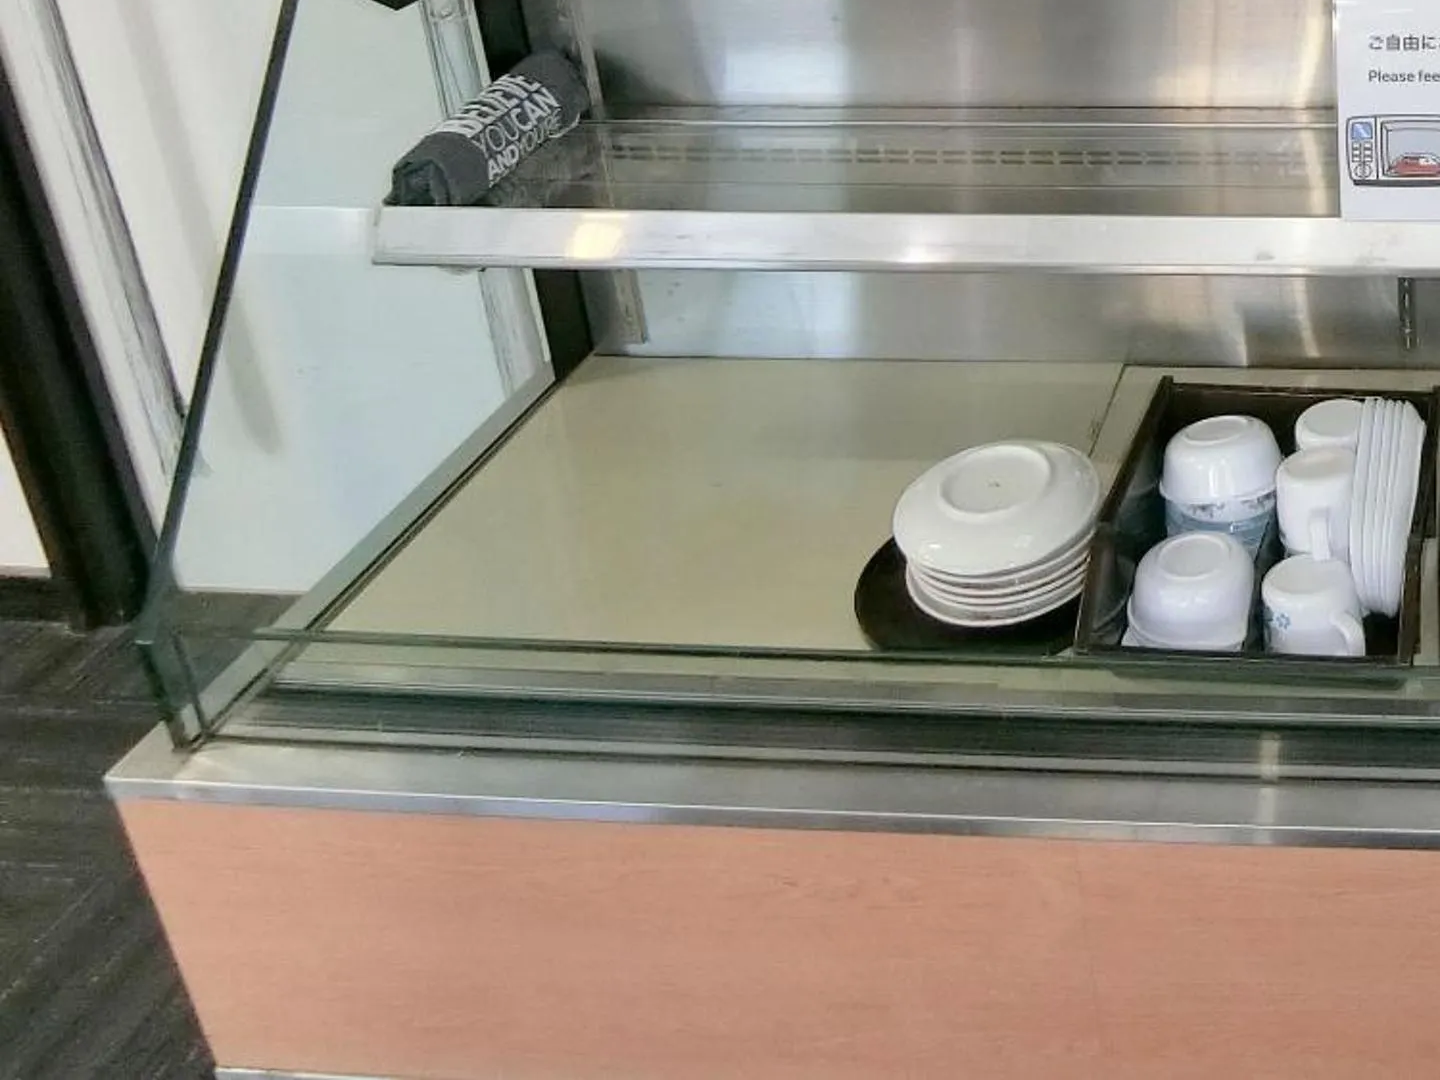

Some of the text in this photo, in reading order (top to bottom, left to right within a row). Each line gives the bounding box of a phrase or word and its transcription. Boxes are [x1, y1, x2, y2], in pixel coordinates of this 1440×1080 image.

[1368, 69, 1415, 83] Please
[472, 87, 562, 159] YOU CAN
[488, 145, 519, 180] AND
